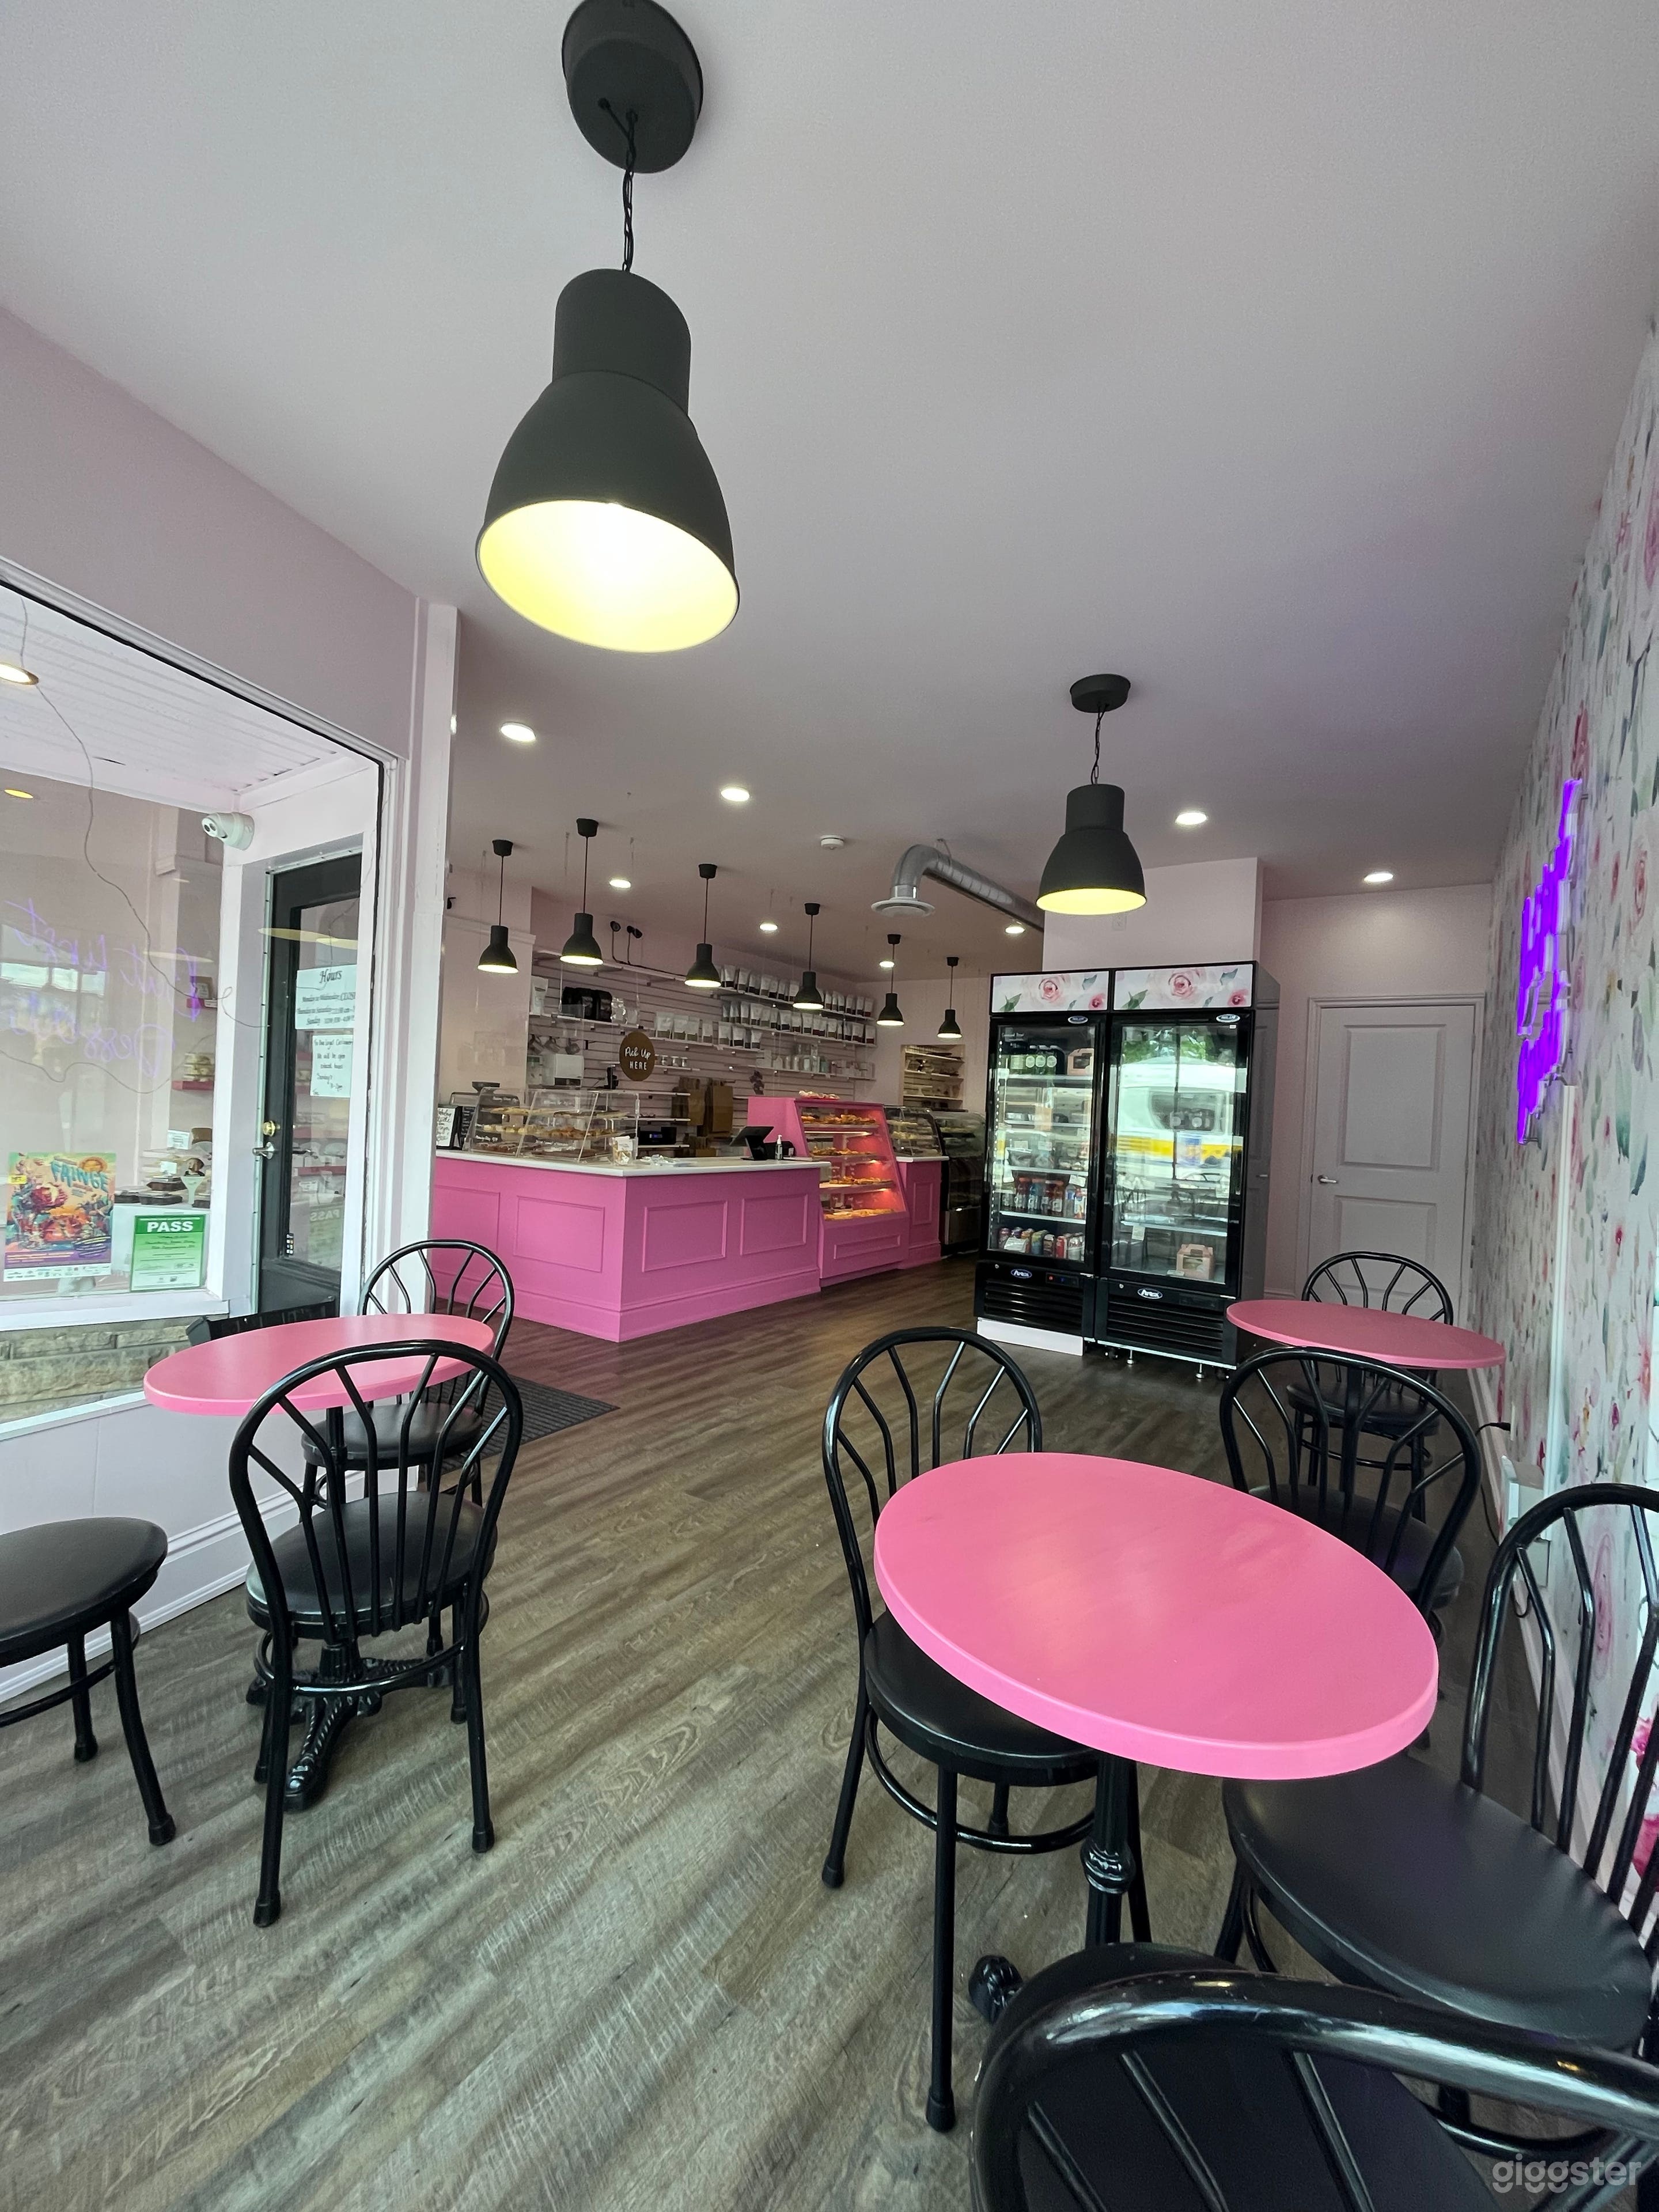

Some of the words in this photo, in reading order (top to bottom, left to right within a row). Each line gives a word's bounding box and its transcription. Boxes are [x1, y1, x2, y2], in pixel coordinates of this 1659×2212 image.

[319, 968, 343, 984] Hours
[625, 1046, 639, 1057] Pick
[641, 1048, 651, 1060] Up
[629, 1061, 647, 1070] HERE
[147, 1220, 194, 1233] PASS
